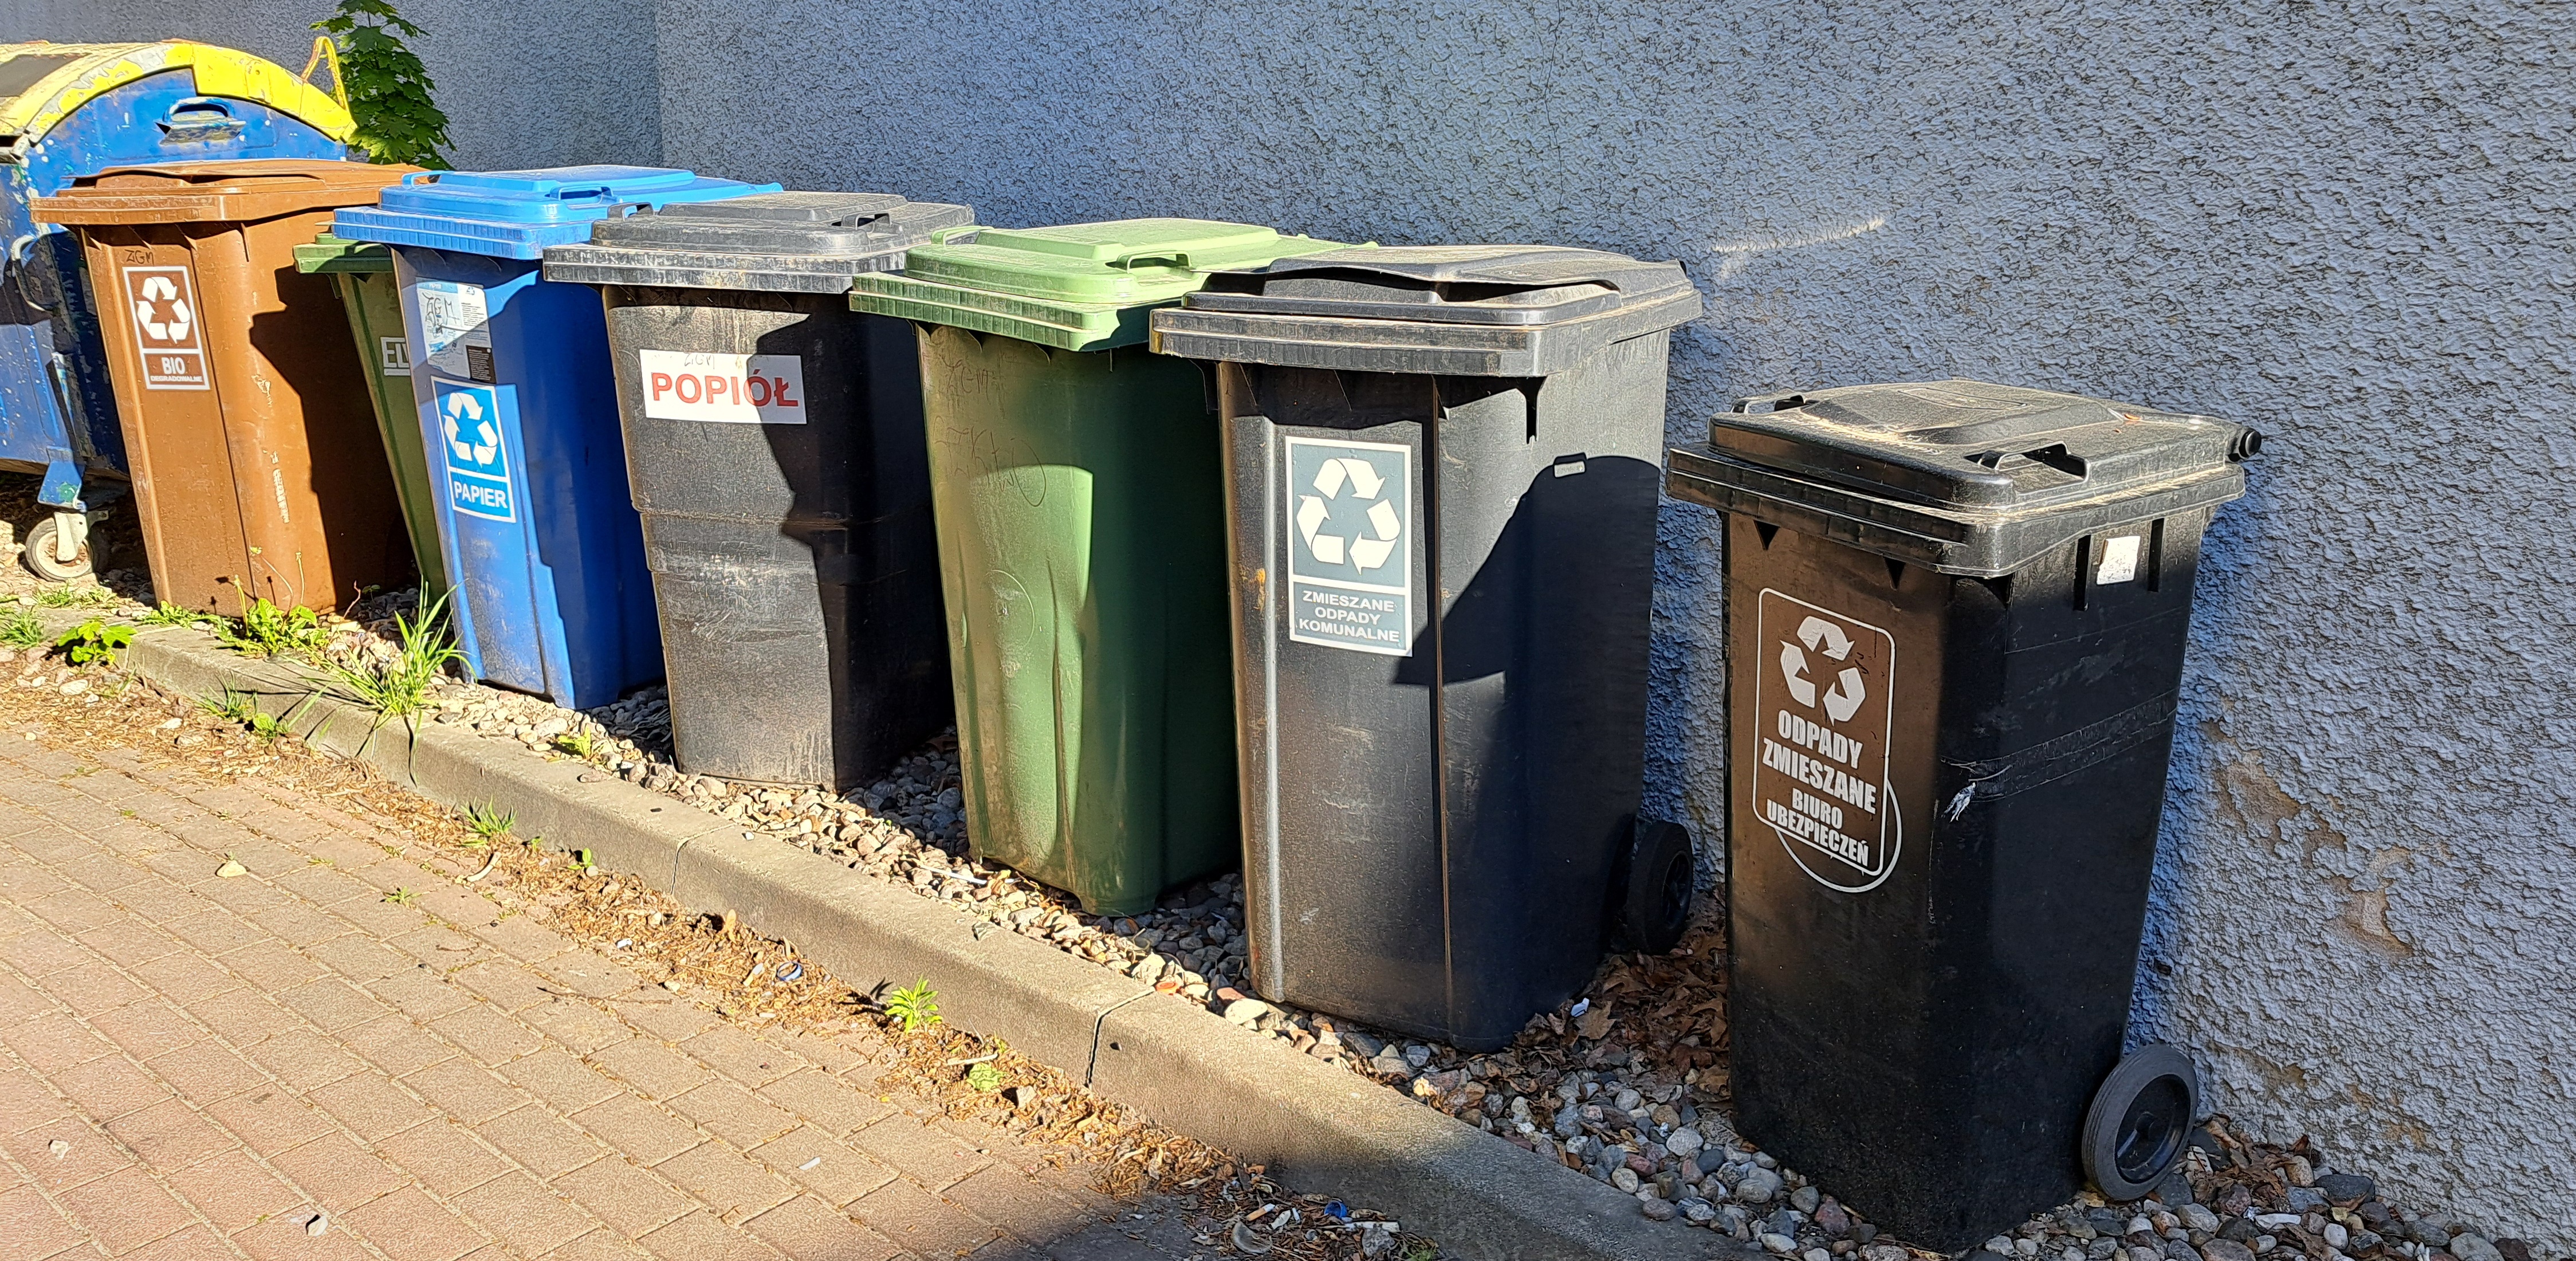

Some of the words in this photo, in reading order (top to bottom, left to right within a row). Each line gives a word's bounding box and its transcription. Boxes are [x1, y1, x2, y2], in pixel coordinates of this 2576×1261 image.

[124, 249, 155, 265] ZGM
[162, 357, 185, 374] BIO
[651, 369, 799, 407] POPIÓŁ
[454, 481, 508, 509] PAPIER
[1302, 590, 1395, 612] ZMIESZANE
[1299, 618, 1399, 642] KOMUNALNE
[1315, 607, 1381, 625] ODPADY
[1777, 709, 1863, 769] ODPADY
[1762, 737, 1877, 815] ZMIESZANE
[1792, 787, 1843, 830] BIURO
[1767, 799, 1869, 866] UBEZPIECZEŃ
